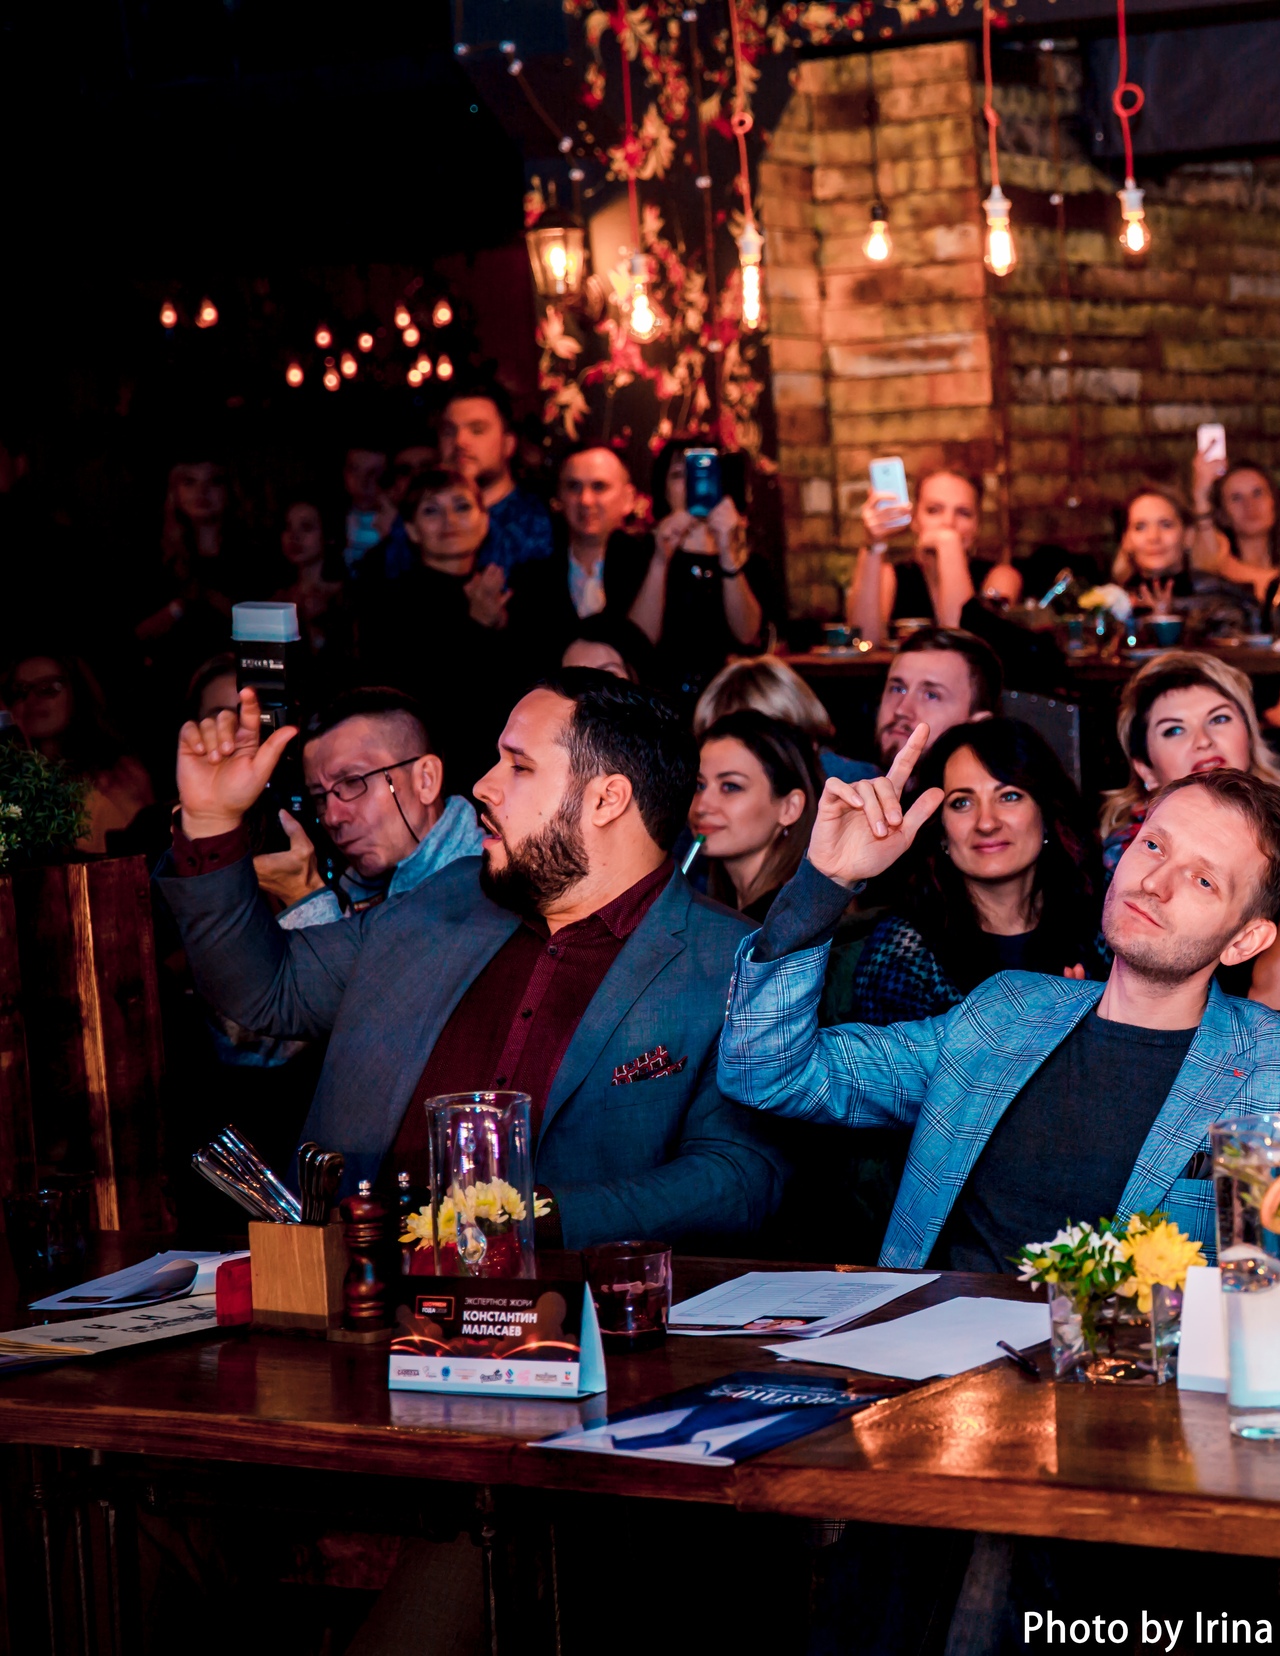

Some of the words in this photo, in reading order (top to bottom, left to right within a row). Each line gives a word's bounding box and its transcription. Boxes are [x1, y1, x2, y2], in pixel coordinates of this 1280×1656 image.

[464, 1297, 507, 1306] ЭКСПЕРТНОЕ
[509, 1299, 533, 1307] ЖЮРИ
[462, 1310, 538, 1323] КОНСТАНТИН
[461, 1324, 522, 1336] МАЛАСАЕВ
